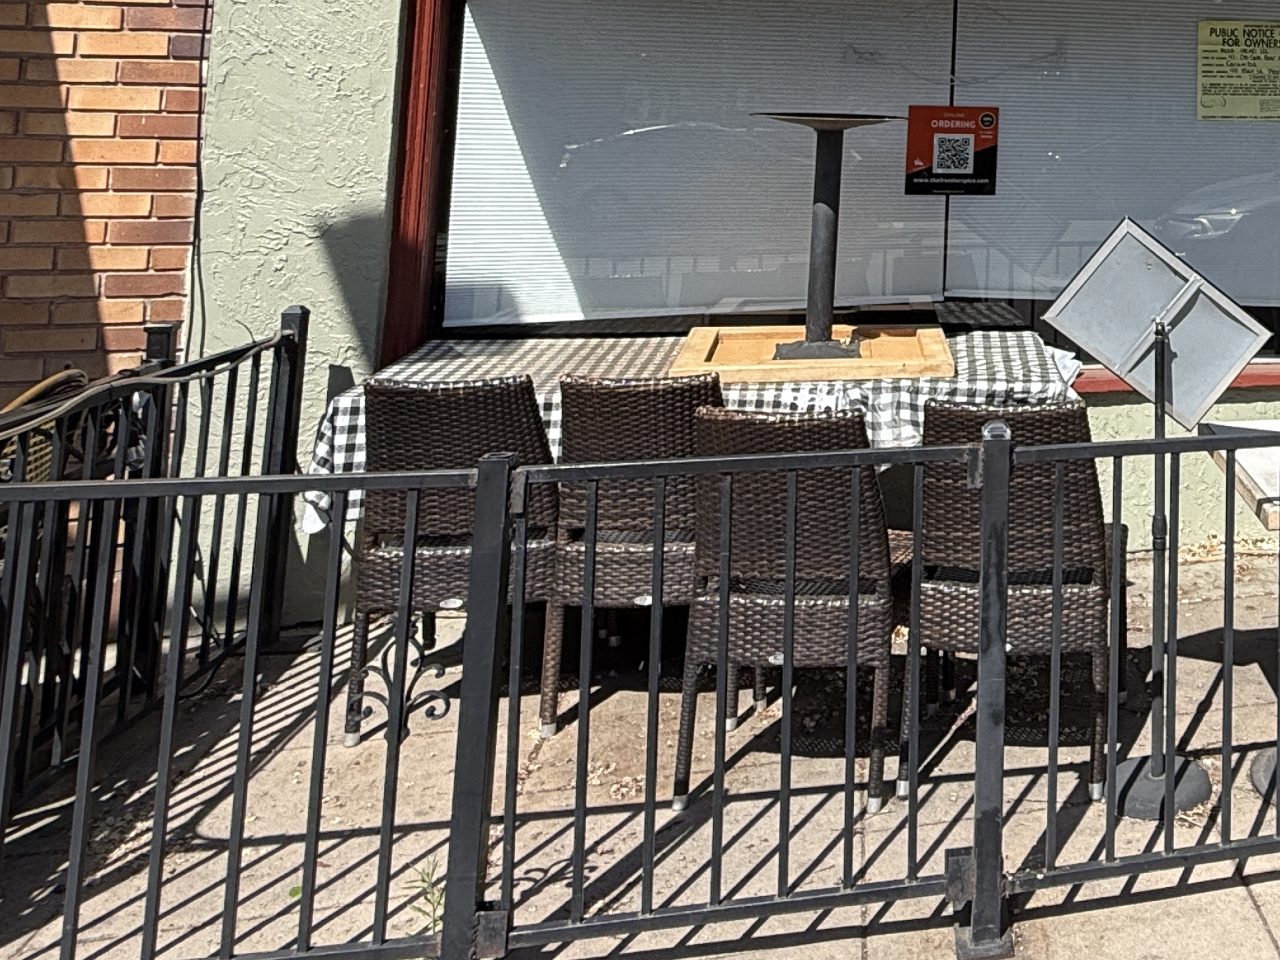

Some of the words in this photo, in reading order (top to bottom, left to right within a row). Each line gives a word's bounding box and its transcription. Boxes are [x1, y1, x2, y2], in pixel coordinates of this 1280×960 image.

[1209, 27, 1239, 39] PUBLIC
[1242, 28, 1275, 39] NOTICE
[1222, 38, 1240, 48] FOR
[930, 119, 977, 129] ORDERING
